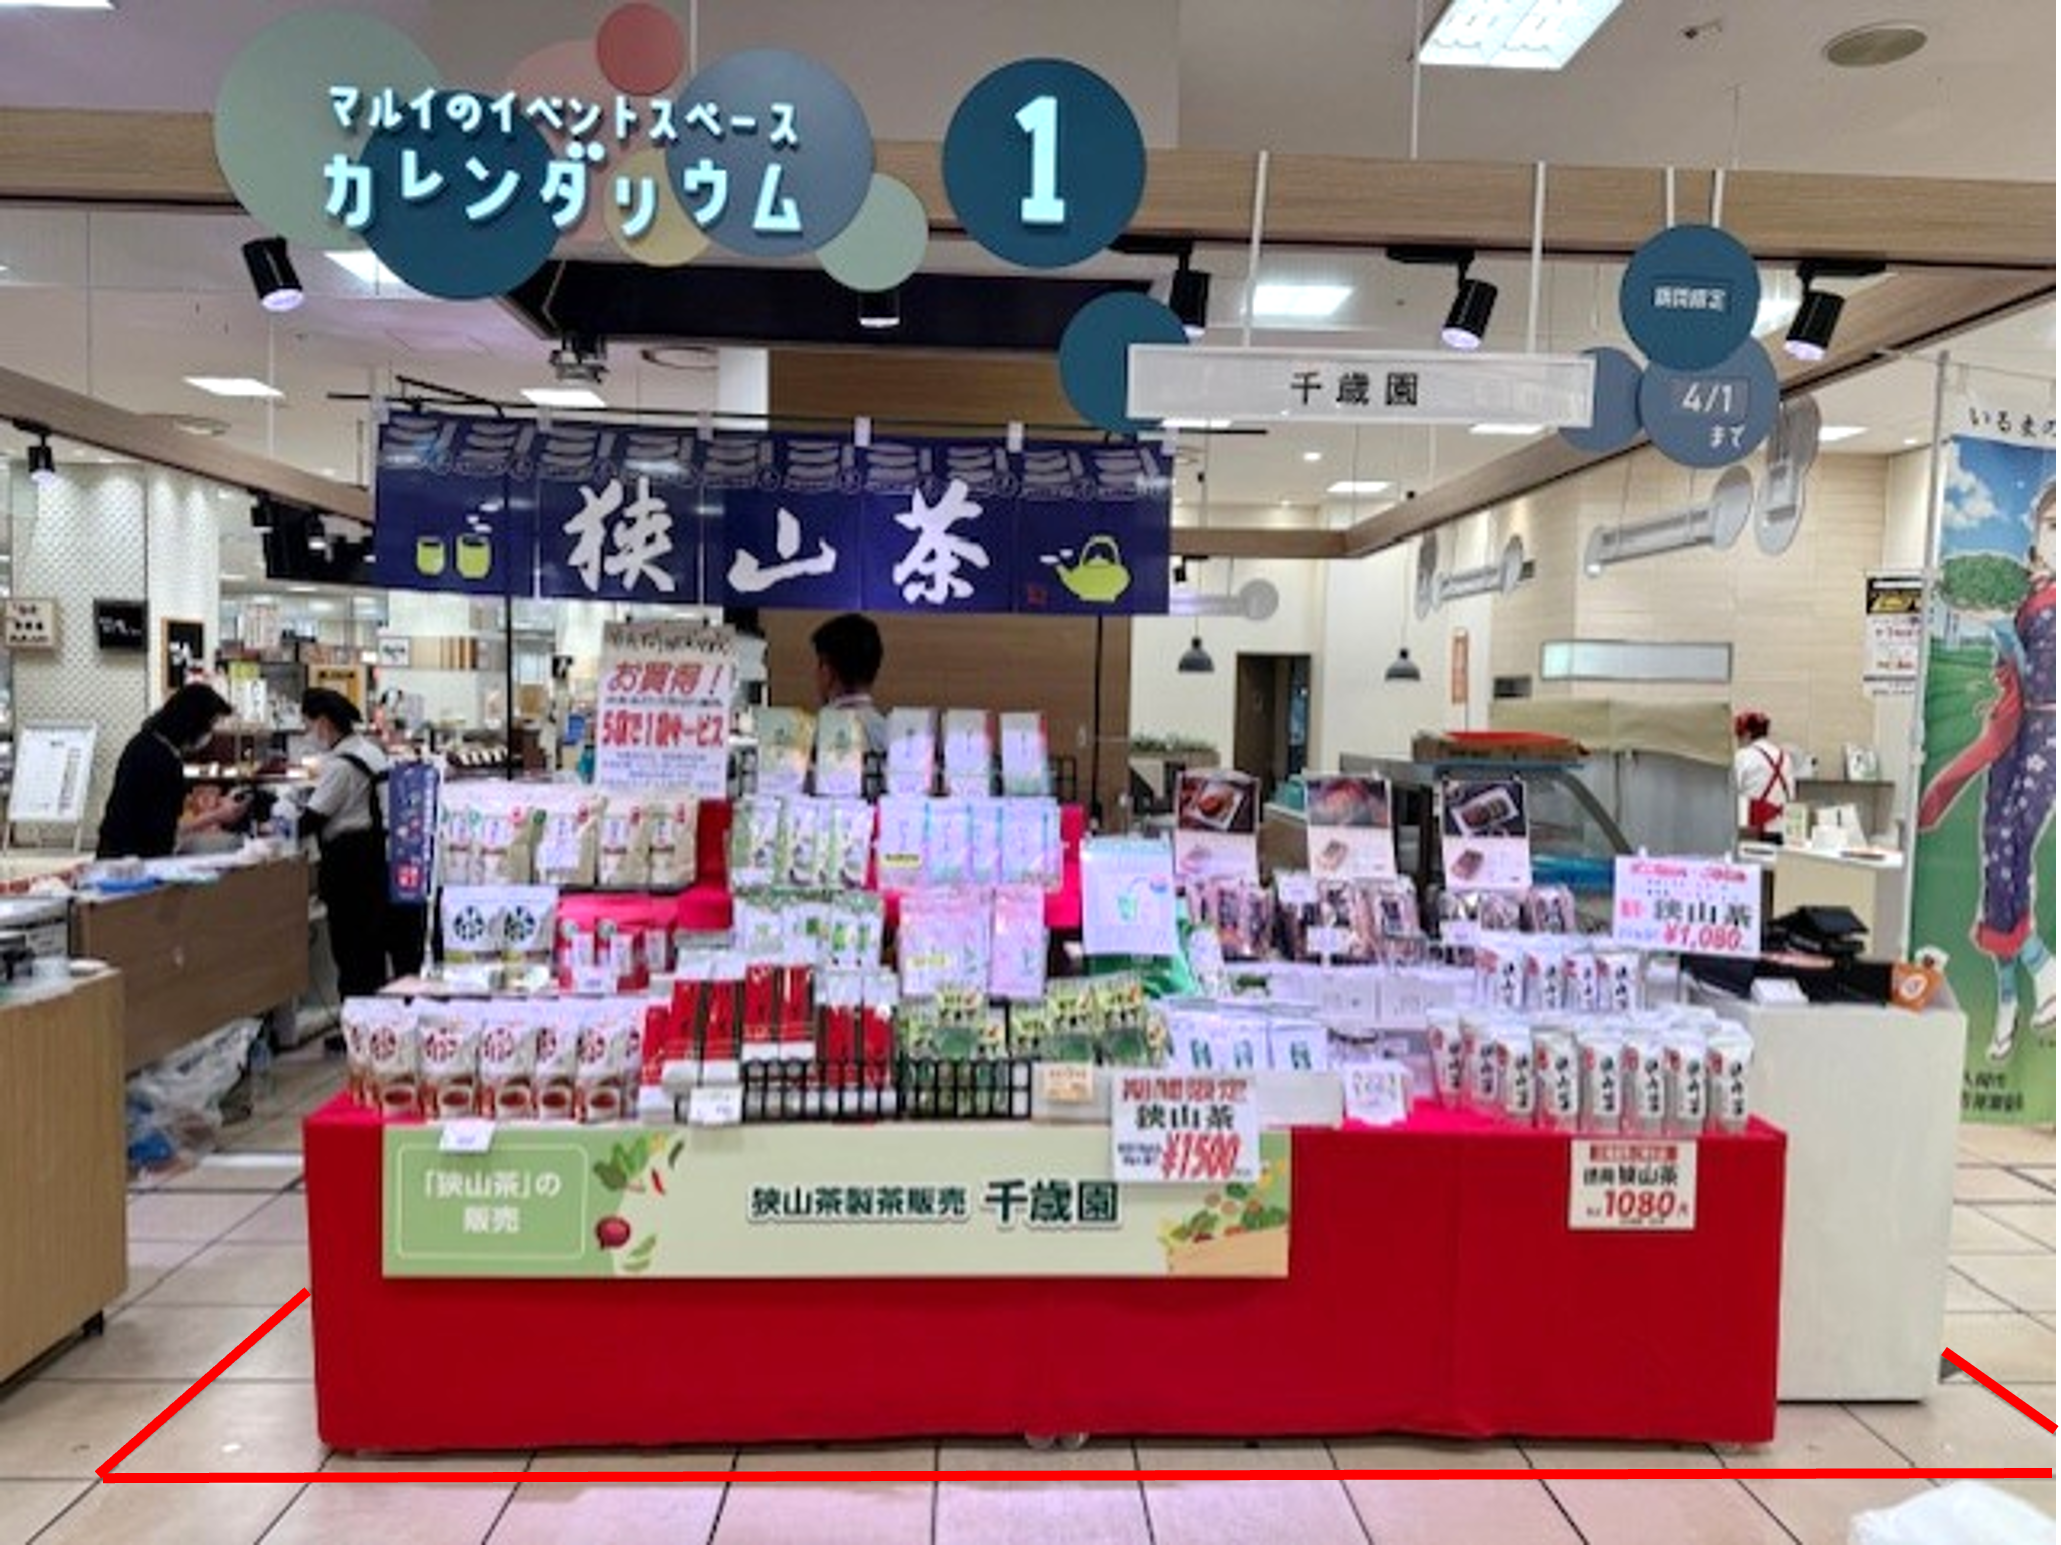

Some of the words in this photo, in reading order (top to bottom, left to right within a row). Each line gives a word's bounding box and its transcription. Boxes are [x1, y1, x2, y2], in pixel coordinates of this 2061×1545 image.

[328, 85, 799, 145] マルイのイベントスペース
[1014, 95, 1066, 223] 1
[323, 142, 803, 237] カレンダリウム
[1290, 371, 1419, 405] 千歳園
[1681, 382, 1733, 413] 4/1
[1710, 425, 1746, 449] まで
[564, 478, 990, 607] 狭山茶
[1137, 1104, 1234, 1130] 狭山茶
[424, 1168, 563, 1199] 「狭山茶」の
[751, 1185, 967, 1217] 狭山茶製茶販売
[984, 1178, 1119, 1223] 千歳園
[463, 1204, 521, 1234] 販売
